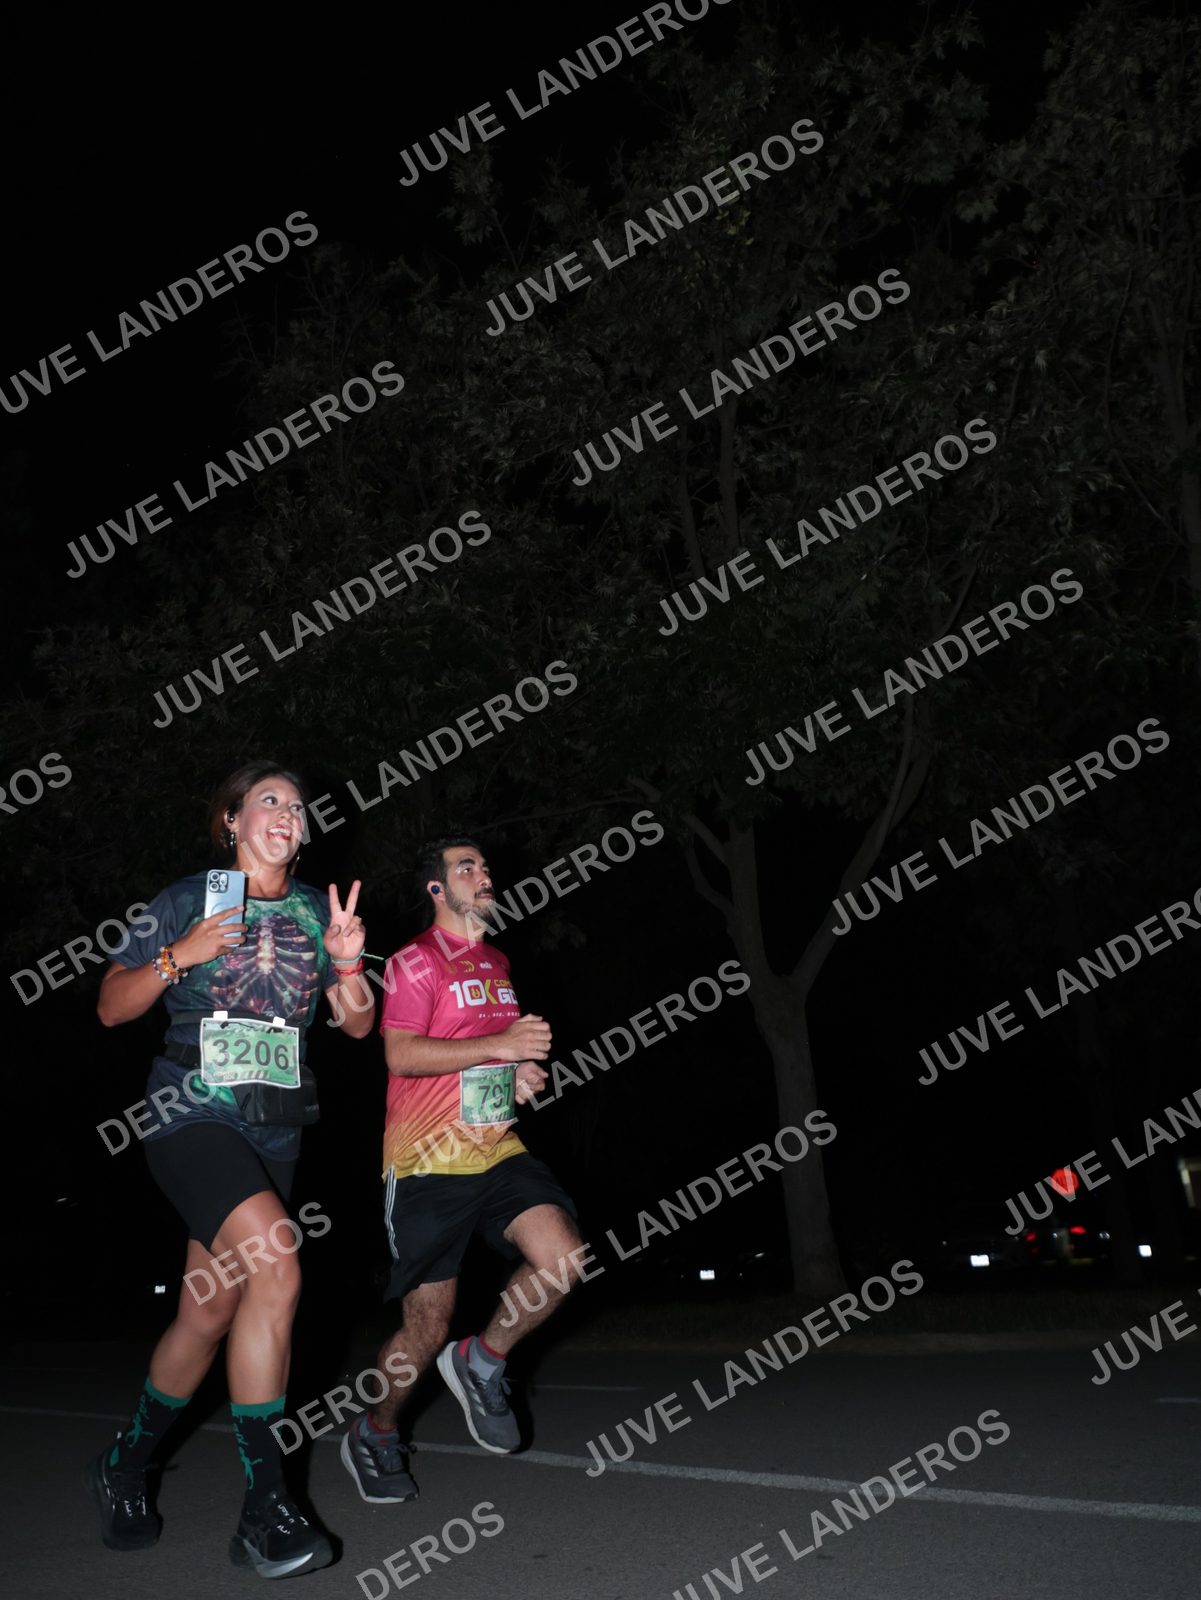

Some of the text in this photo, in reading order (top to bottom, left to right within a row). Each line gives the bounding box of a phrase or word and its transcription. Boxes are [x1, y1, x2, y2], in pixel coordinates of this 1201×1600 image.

[449, 979, 498, 1009] 10K
[212, 1039, 289, 1070] 3206
[478, 1082, 511, 1110] 797
